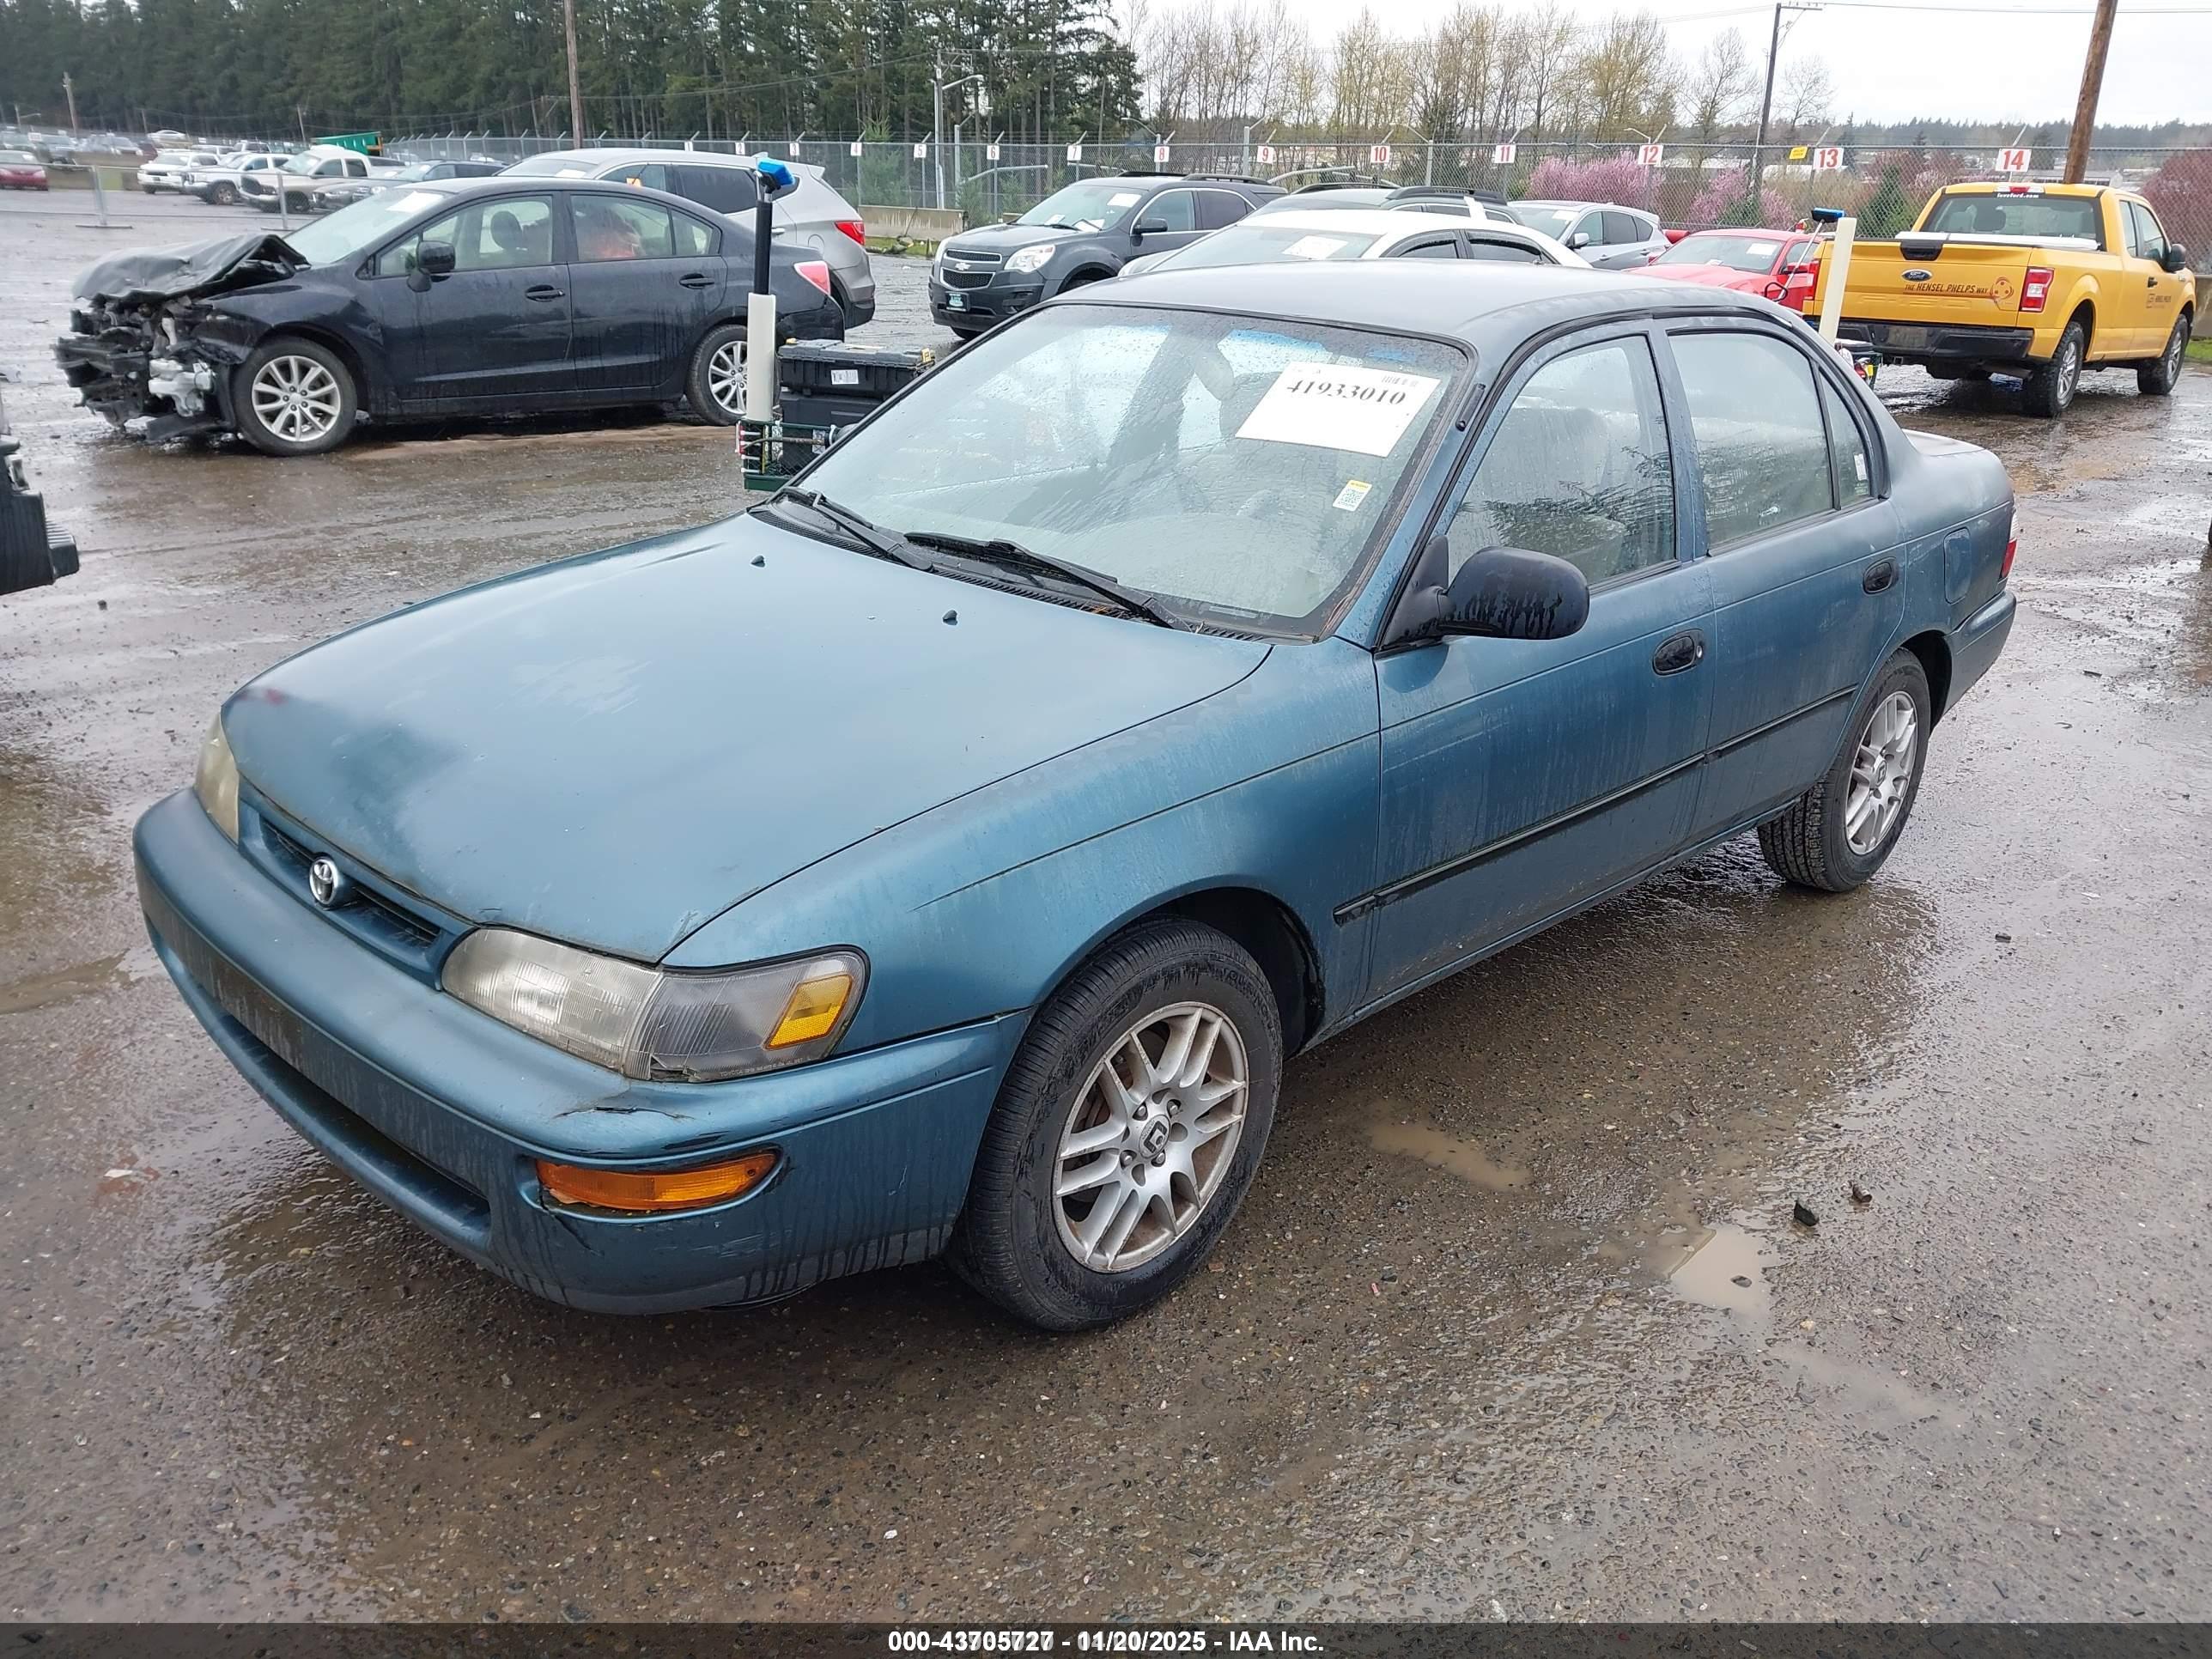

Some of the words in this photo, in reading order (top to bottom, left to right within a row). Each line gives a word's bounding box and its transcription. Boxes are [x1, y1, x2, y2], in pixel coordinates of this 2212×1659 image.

[738, 143, 743, 154] 2
[791, 143, 797, 154] 3
[917, 143, 923, 156] 5
[990, 145, 996, 159] 6
[1073, 145, 1079, 159] 7
[1158, 148, 1165, 161] 8
[1262, 147, 1269, 161] 9
[1375, 147, 1387, 161] 10
[1499, 146, 1511, 161] 11
[1643, 146, 1659, 163] 12
[1819, 148, 1839, 167] 13
[2003, 150, 2024, 170] 14
[1916, 283, 1945, 292] HENSEL
[1946, 284, 1976, 294] PHELPS
[1286, 380, 1407, 404] 41933010
